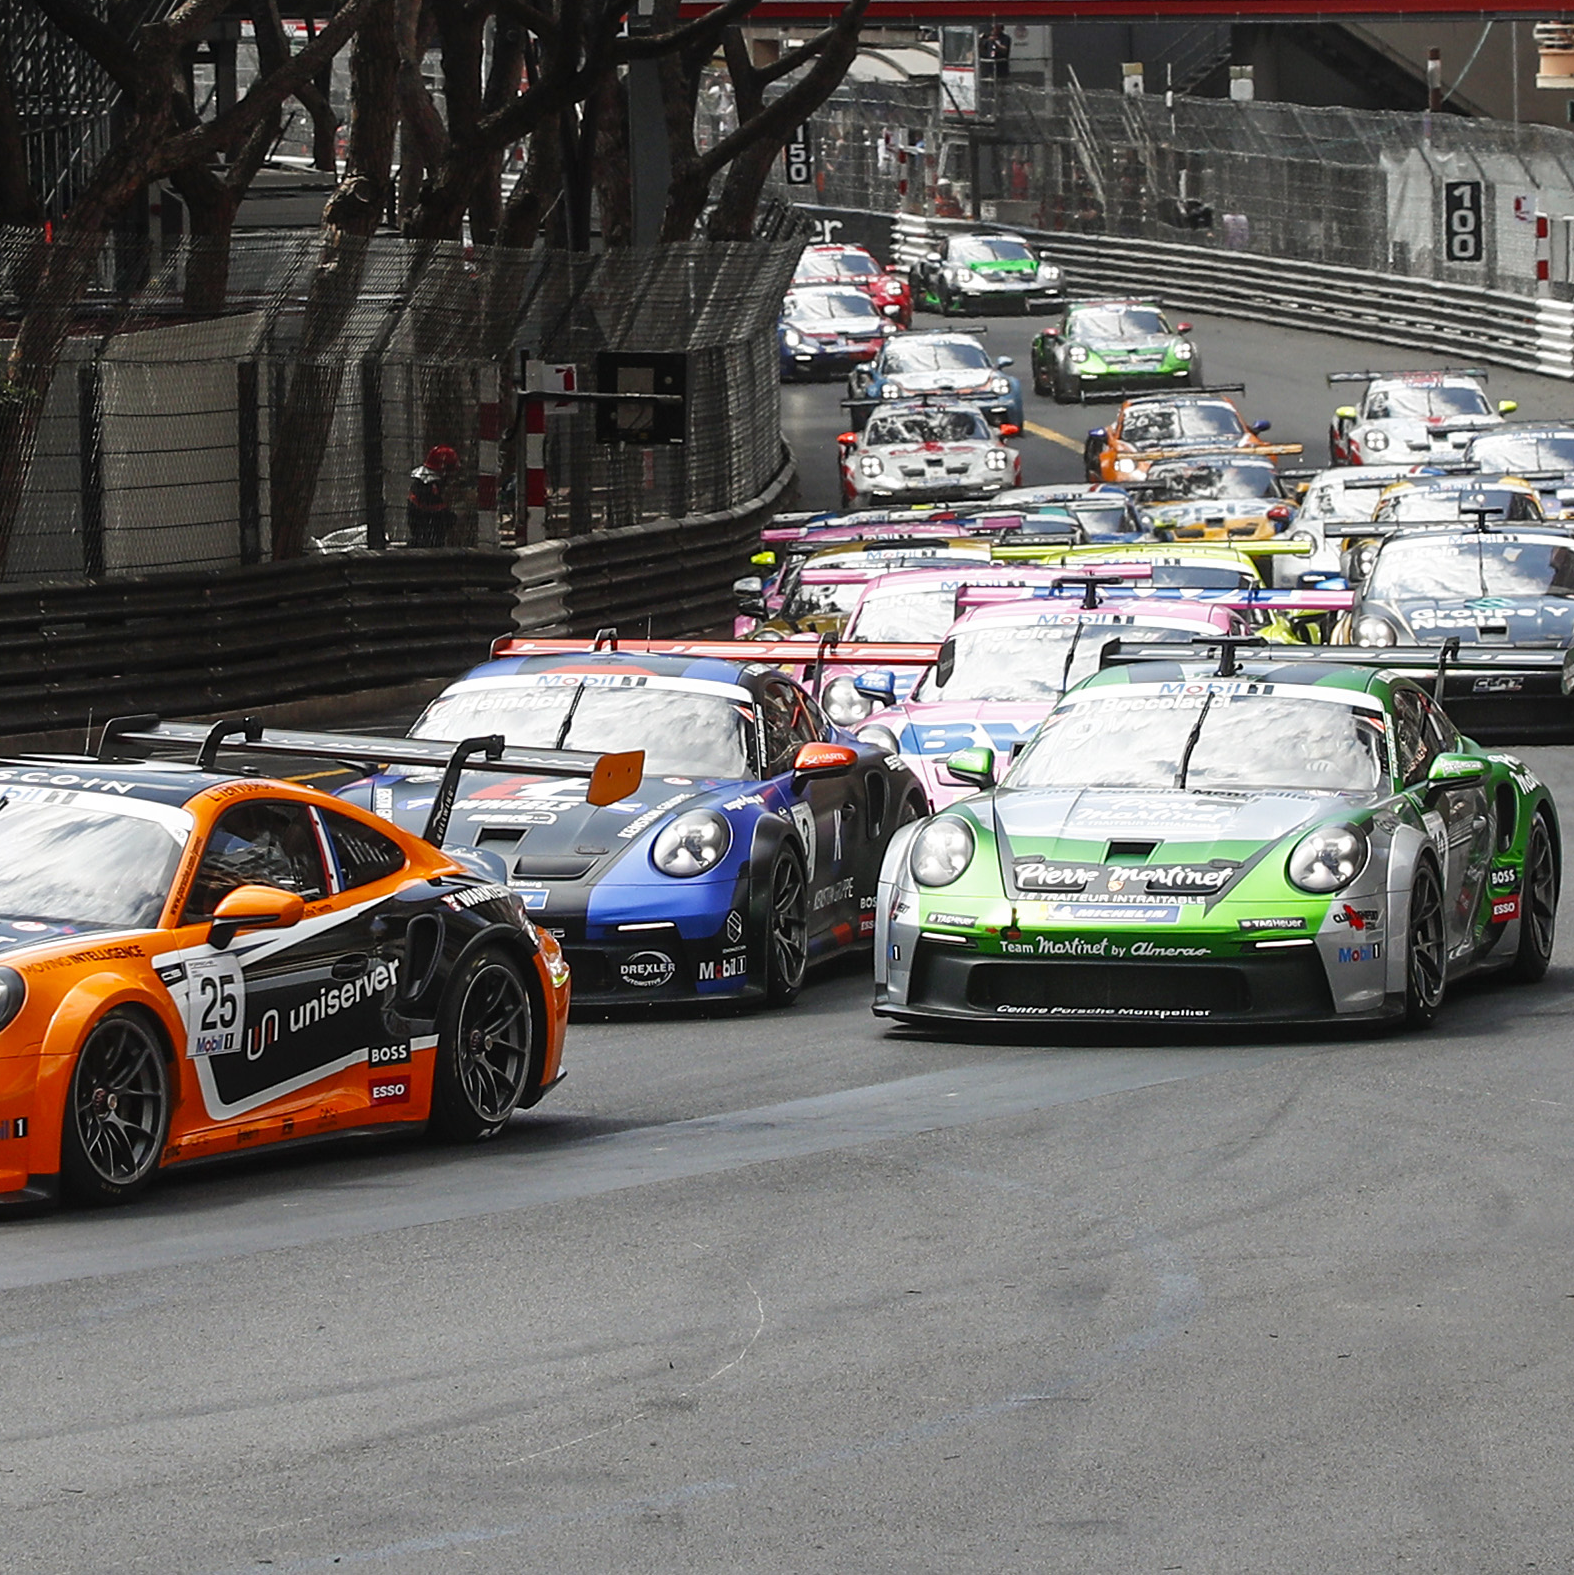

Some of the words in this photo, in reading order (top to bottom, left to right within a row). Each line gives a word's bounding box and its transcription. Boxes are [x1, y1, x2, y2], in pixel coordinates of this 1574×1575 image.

[789, 125, 808, 182] 150
[1452, 185, 1476, 258] 100
[1038, 615, 1107, 625] Mobil
[1411, 607, 1537, 622] Groupe
[1539, 606, 1569, 618] Y
[1411, 617, 1508, 630] Nexia
[978, 627, 1063, 642] Pereira
[536, 675, 615, 686] Mobil
[1160, 682, 1241, 695] Mobil
[457, 692, 571, 715] Heinrich
[1097, 695, 1233, 715] Boccolacci
[452, 798, 579, 811] WHEELS
[1015, 863, 1099, 886] Pierre
[1108, 865, 1234, 888] Martinet
[1492, 868, 1515, 885] BOSS
[860, 897, 877, 910] BOS
[1018, 892, 1039, 901] LE
[1040, 893, 1109, 903] TRAITEUR
[1111, 894, 1206, 905] INTRAITABLE
[1076, 907, 1169, 919] MICHELIN
[1494, 902, 1515, 915] ESSO
[1000, 940, 1034, 954] Team
[1036, 936, 1108, 956] Martinet
[1111, 944, 1126, 957] by
[1130, 942, 1211, 957] Almeras
[1338, 946, 1372, 963] Mobil
[24, 955, 73, 976] MOVING
[73, 945, 145, 965] INTELLIGENCE
[620, 962, 675, 976] DREXLER
[699, 958, 736, 980] Mobil
[623, 975, 662, 987] AUTOMOTIVE
[200, 974, 237, 1032] 25
[289, 958, 400, 1032] uniserver
[996, 1004, 1048, 1014] Centre
[1051, 1007, 1115, 1015] Porsche
[1118, 1008, 1212, 1019] Montpellier
[195, 1035, 223, 1054] Mobil
[224, 1033, 235, 1050] 1
[371, 1044, 408, 1063] BOSS
[372, 1084, 406, 1099] ESSO
[13, 1117, 28, 1139] 1
